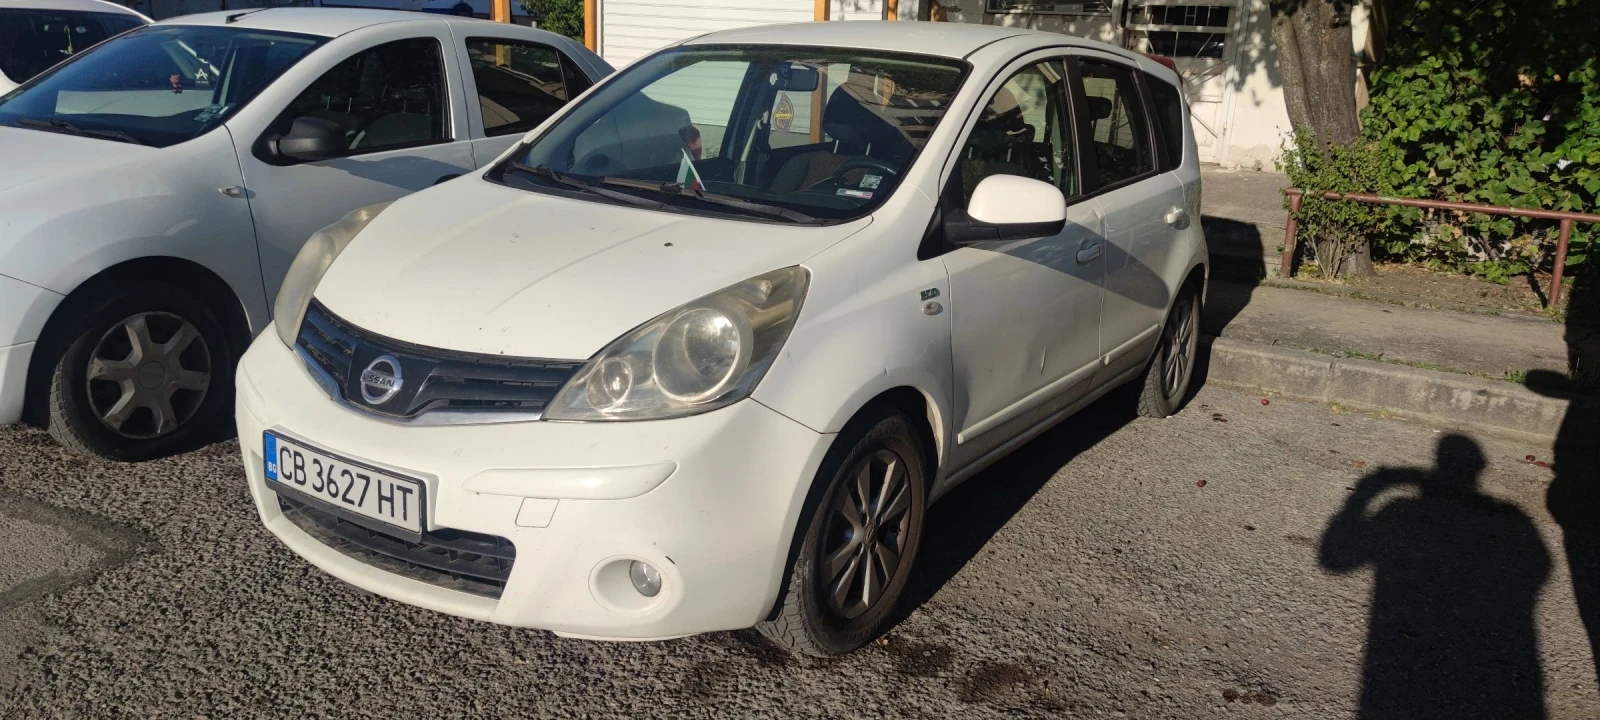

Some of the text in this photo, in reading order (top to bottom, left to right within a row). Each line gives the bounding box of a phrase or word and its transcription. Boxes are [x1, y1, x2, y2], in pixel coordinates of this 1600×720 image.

[363, 372, 396, 387] NISSAN
[268, 461, 277, 474] BG
[279, 446, 414, 522] CB 3627 HT
